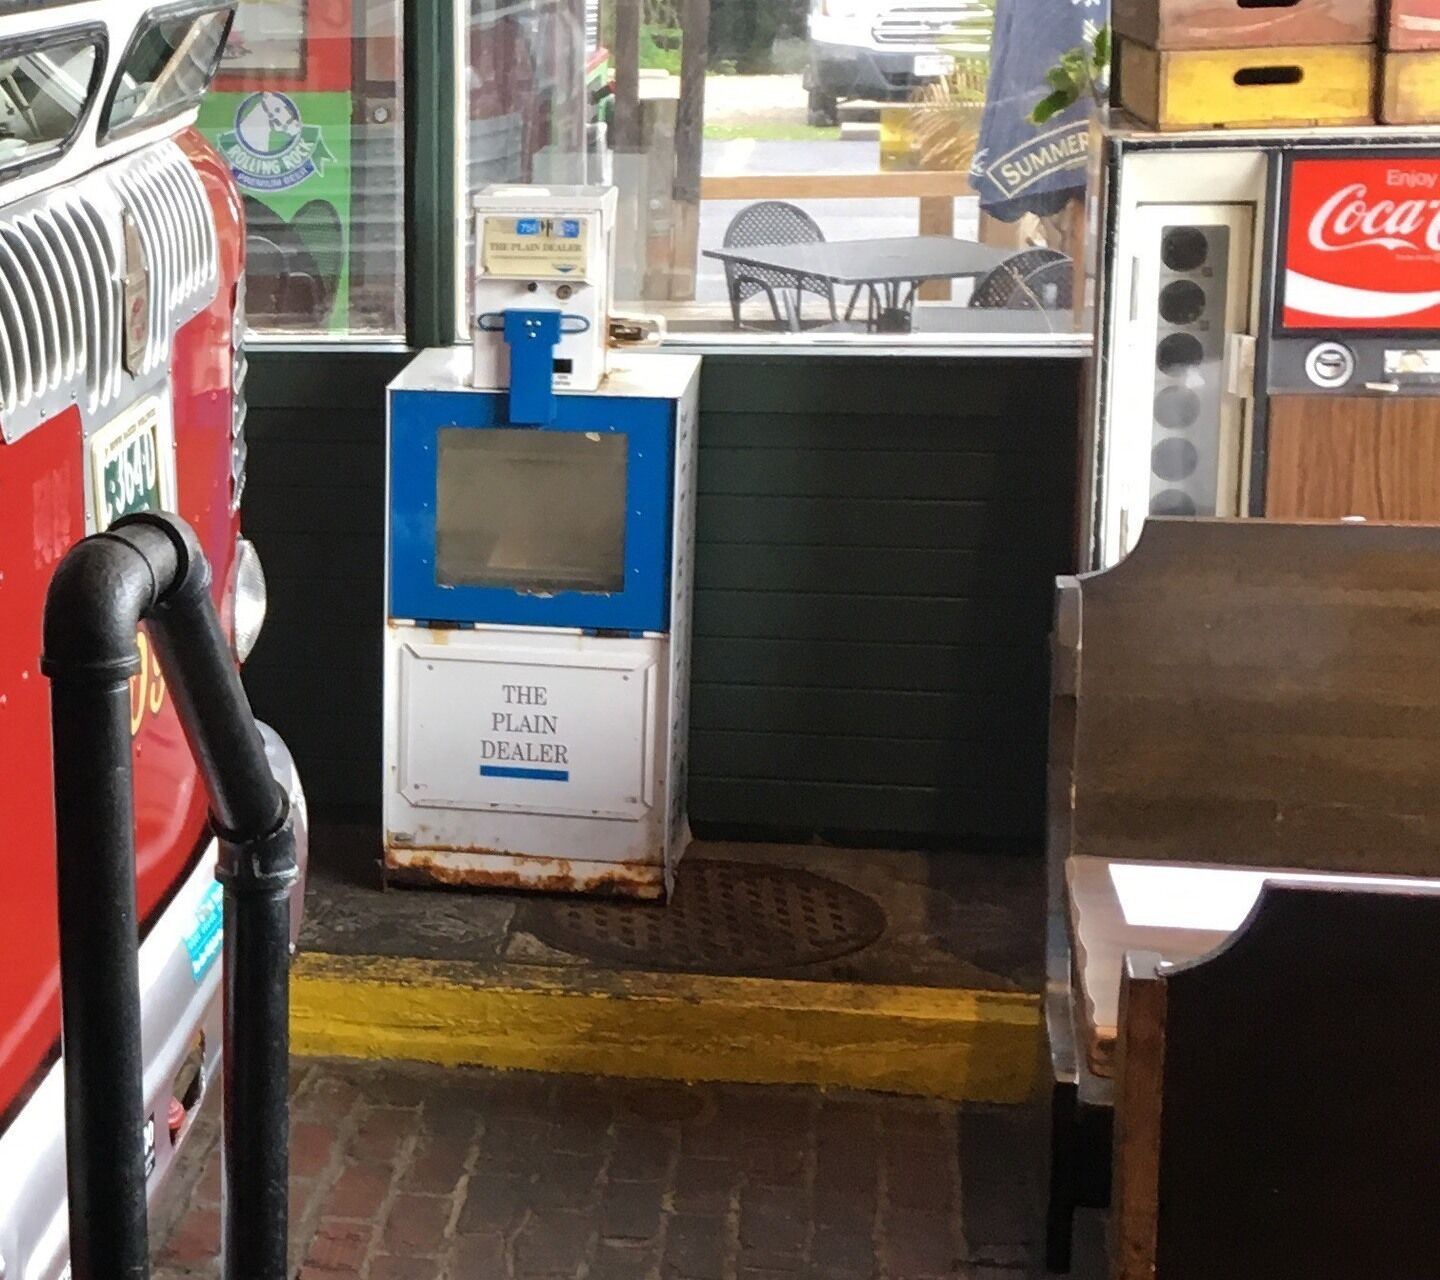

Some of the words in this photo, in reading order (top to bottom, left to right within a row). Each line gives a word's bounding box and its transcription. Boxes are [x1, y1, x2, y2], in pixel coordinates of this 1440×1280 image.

[1386, 169, 1439, 189] Enjoy
[489, 242, 508, 252] THE
[511, 243, 540, 252] PLAIN
[543, 243, 582, 253] DEALER
[502, 684, 548, 706] THE
[491, 712, 558, 735] PLAIN
[480, 740, 569, 764] DEALER
